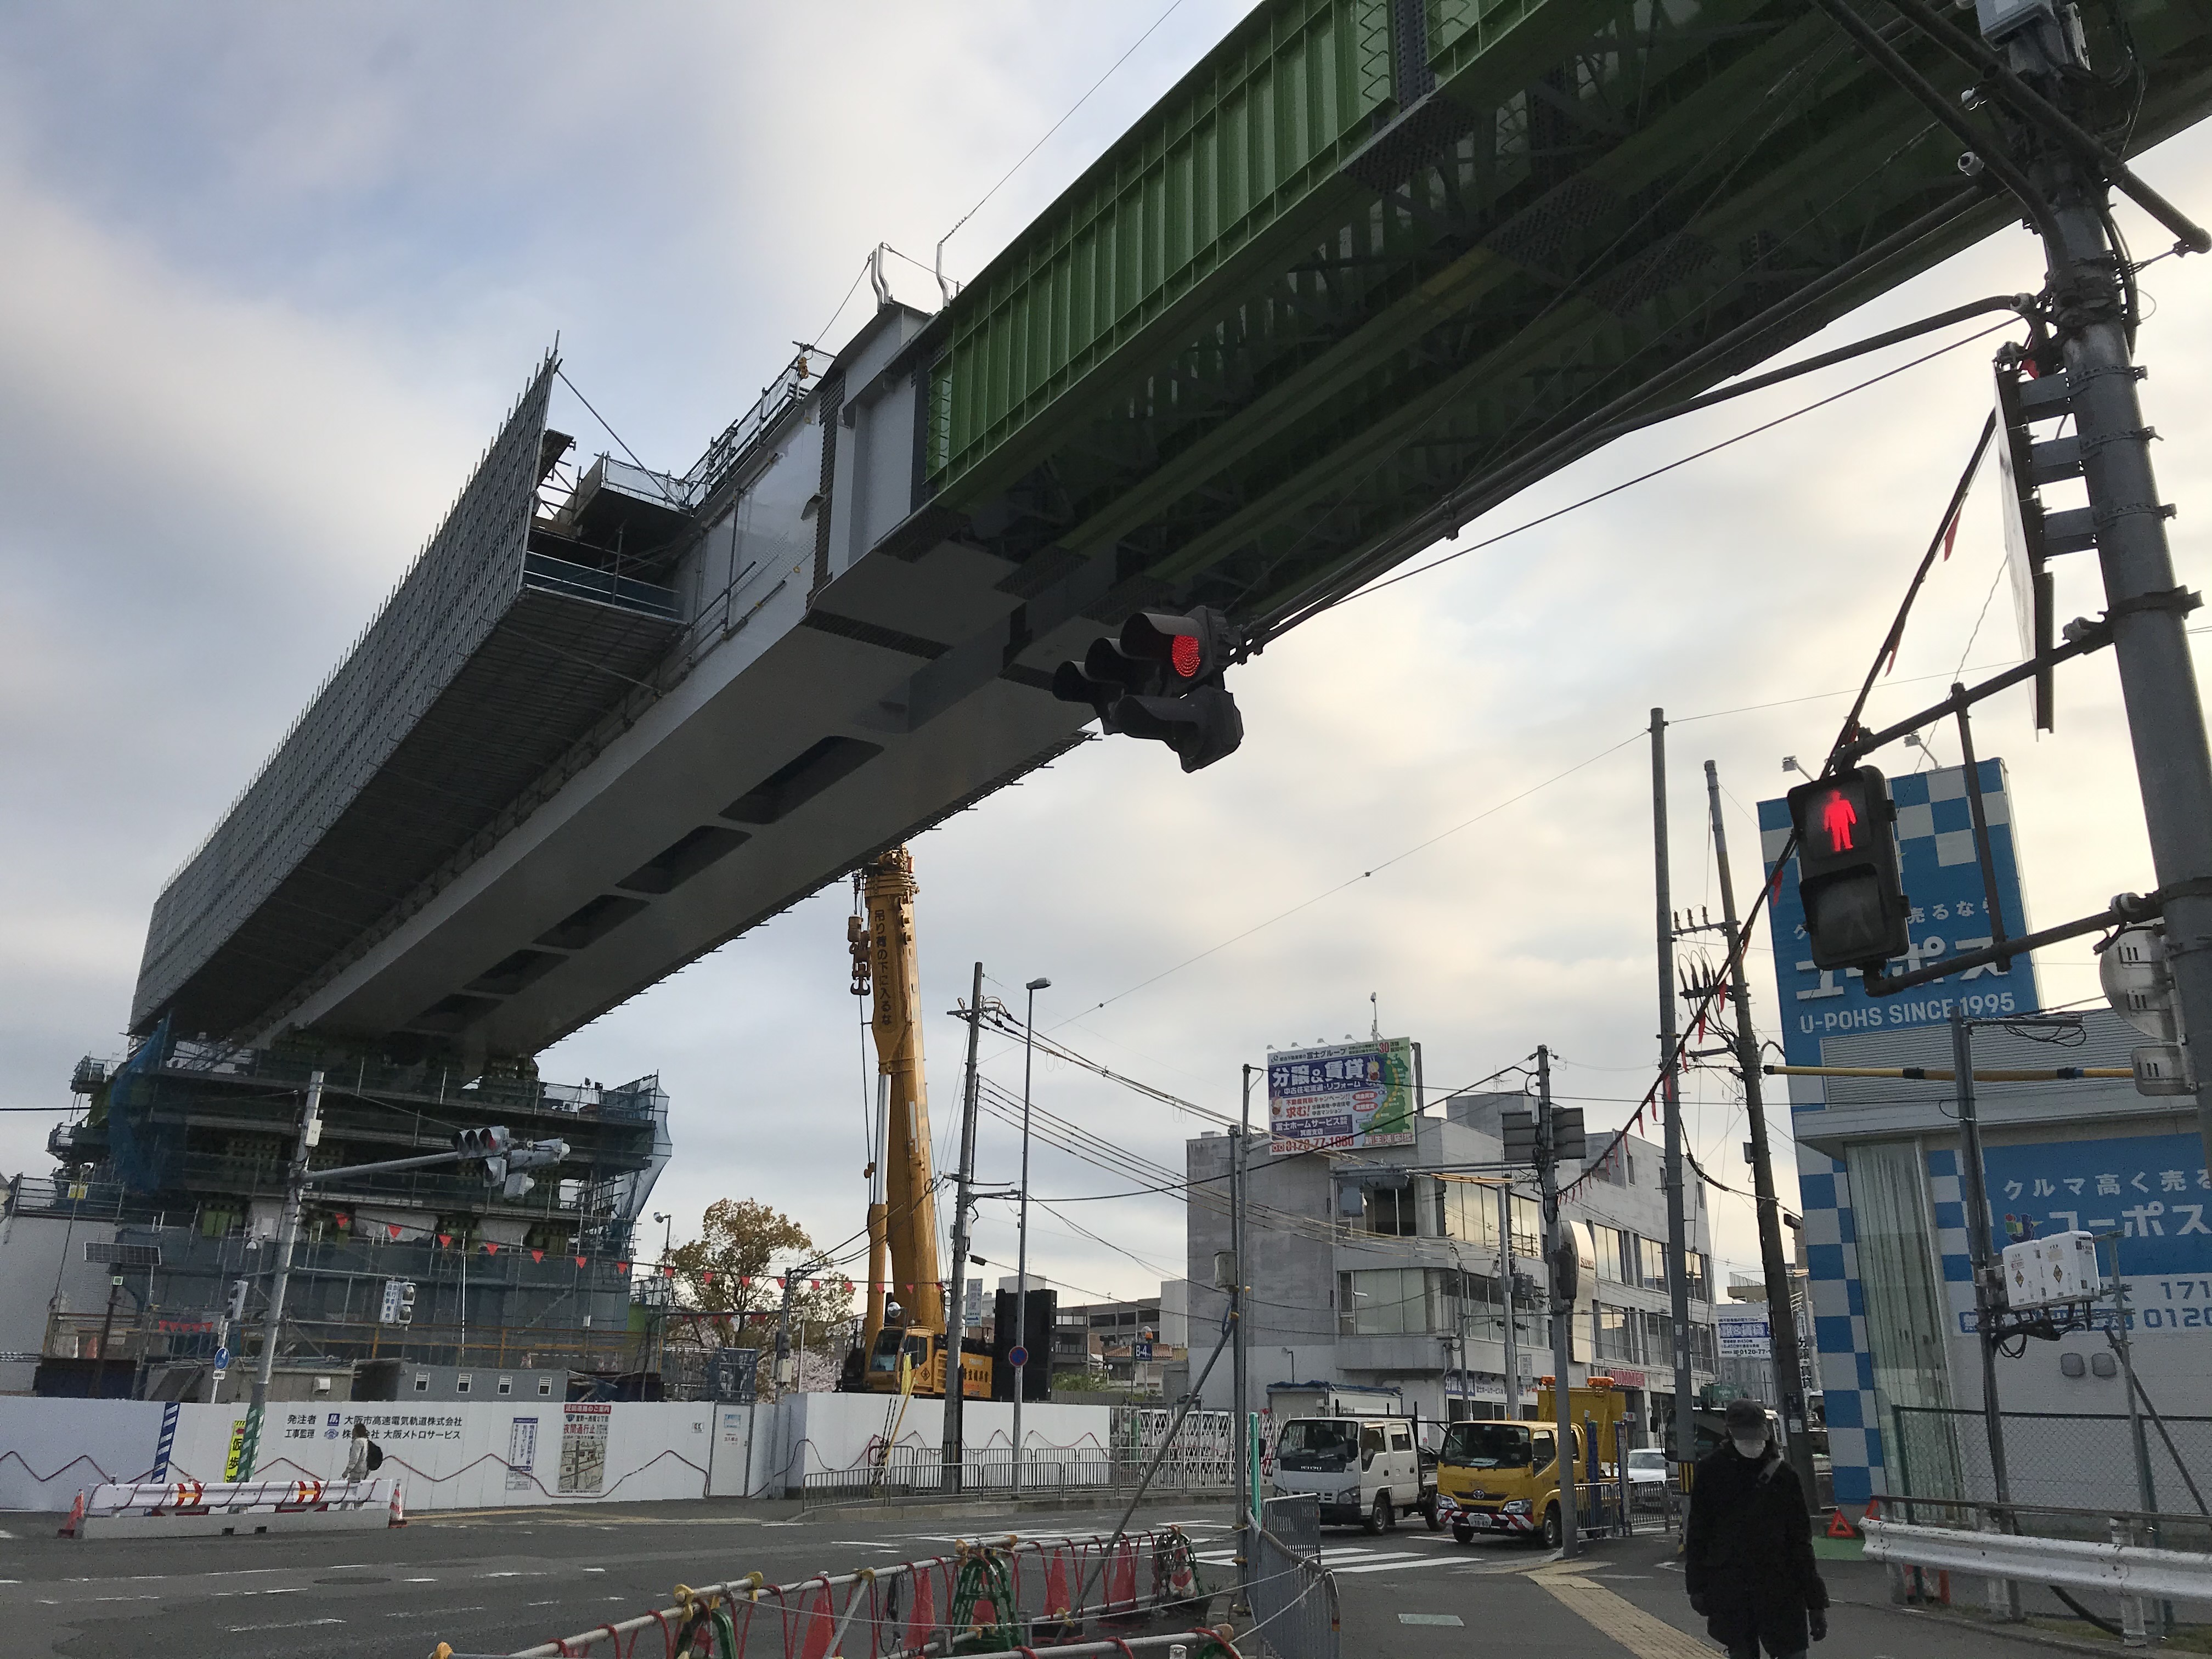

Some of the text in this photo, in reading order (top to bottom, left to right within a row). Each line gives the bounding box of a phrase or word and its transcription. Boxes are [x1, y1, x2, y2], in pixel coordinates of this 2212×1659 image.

[875, 909, 891, 1025] 吊り荷の下に入るな
[1800, 991, 2015, 1034] U-POHS SINCE 1995
[1379, 1042, 1389, 1053] 30
[287, 1414, 317, 1425] 発注者
[344, 1415, 462, 1426] 大阪市高速電気軌道株式会社
[285, 1429, 315, 1439] 工事監理
[383, 1429, 460, 1440] 大阪メトロサービス
